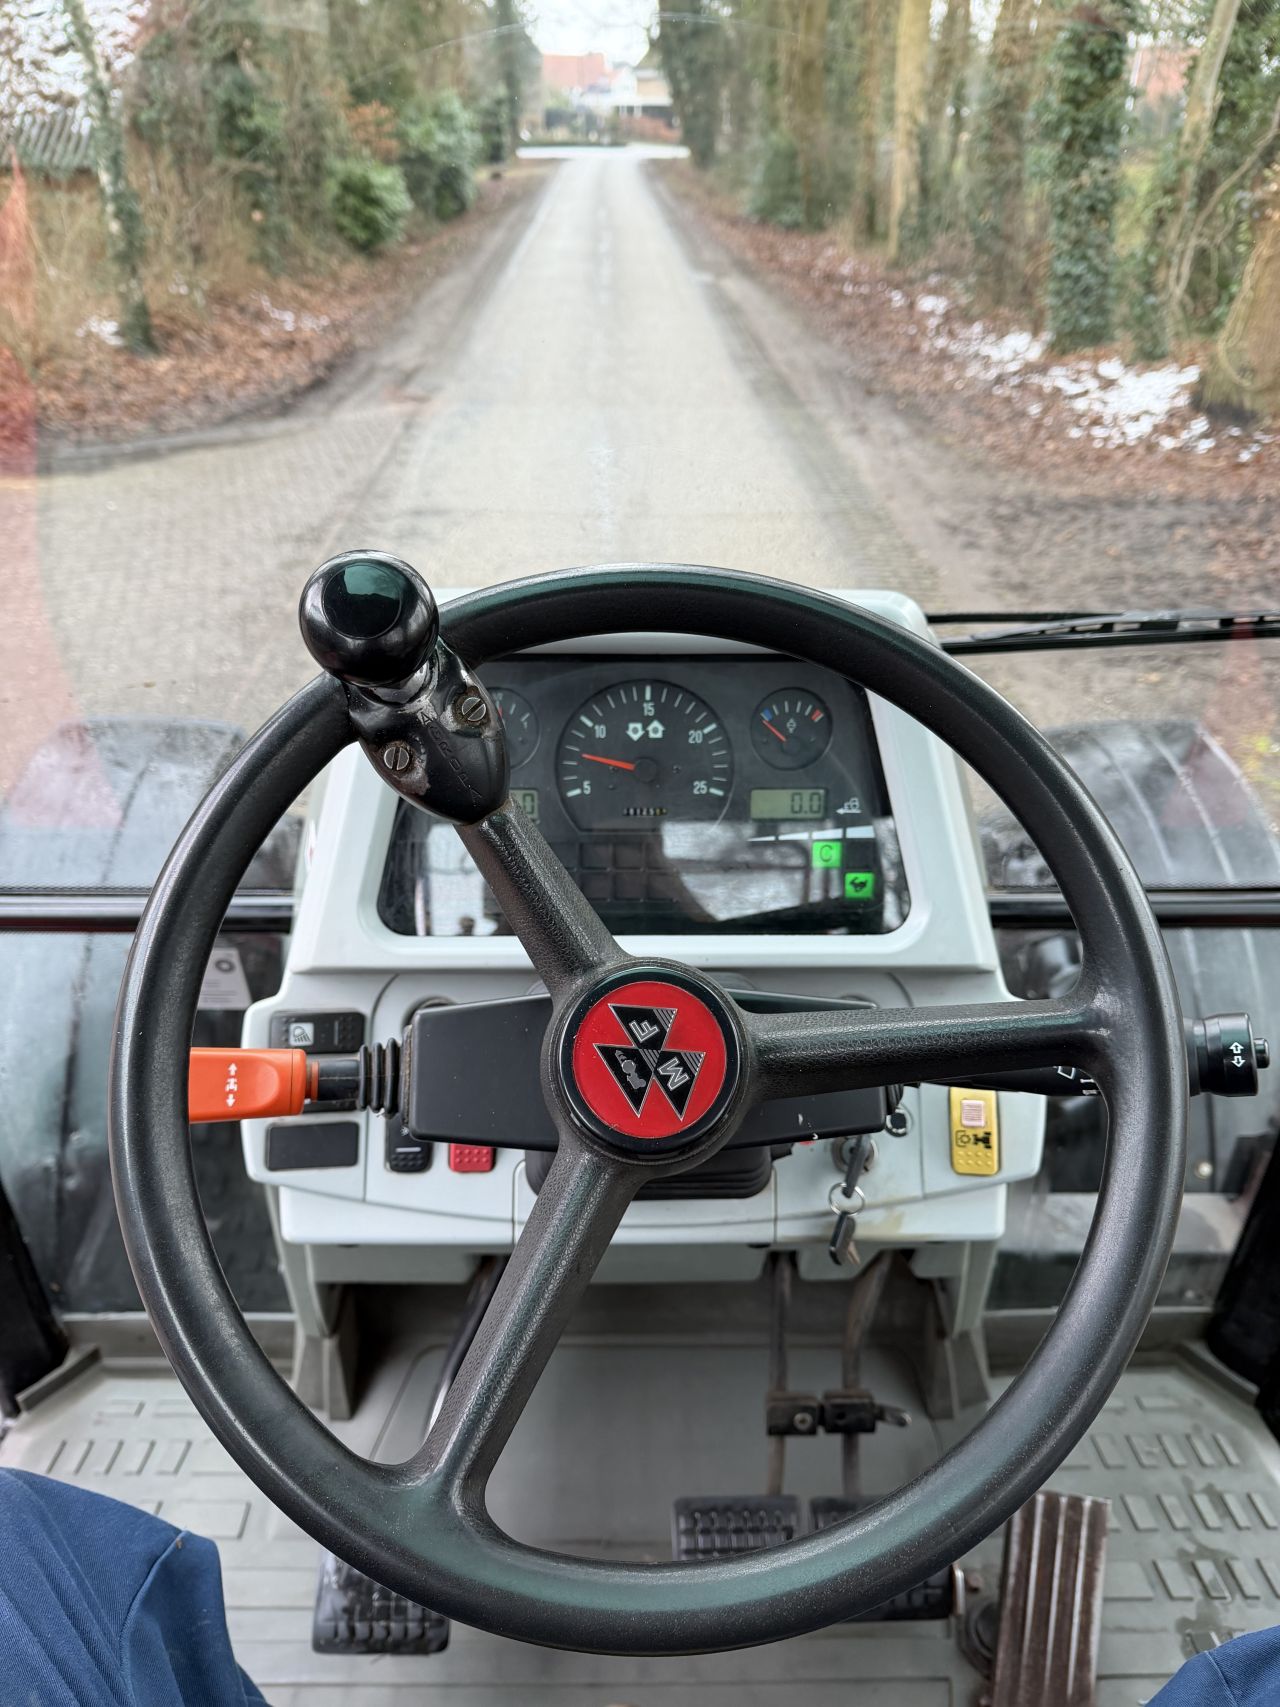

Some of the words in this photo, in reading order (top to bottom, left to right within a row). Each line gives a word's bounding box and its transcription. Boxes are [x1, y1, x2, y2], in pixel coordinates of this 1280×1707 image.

[643, 702, 655, 716] 15
[594, 724, 607, 739] 10
[688, 730, 703, 744] 20
[583, 780, 591, 795] 5
[693, 780, 708, 795] 25
[791, 792, 822, 815] 0.0
[819, 844, 834, 863] C
[628, 1018, 661, 1045] F
[656, 1056, 692, 1092] M
